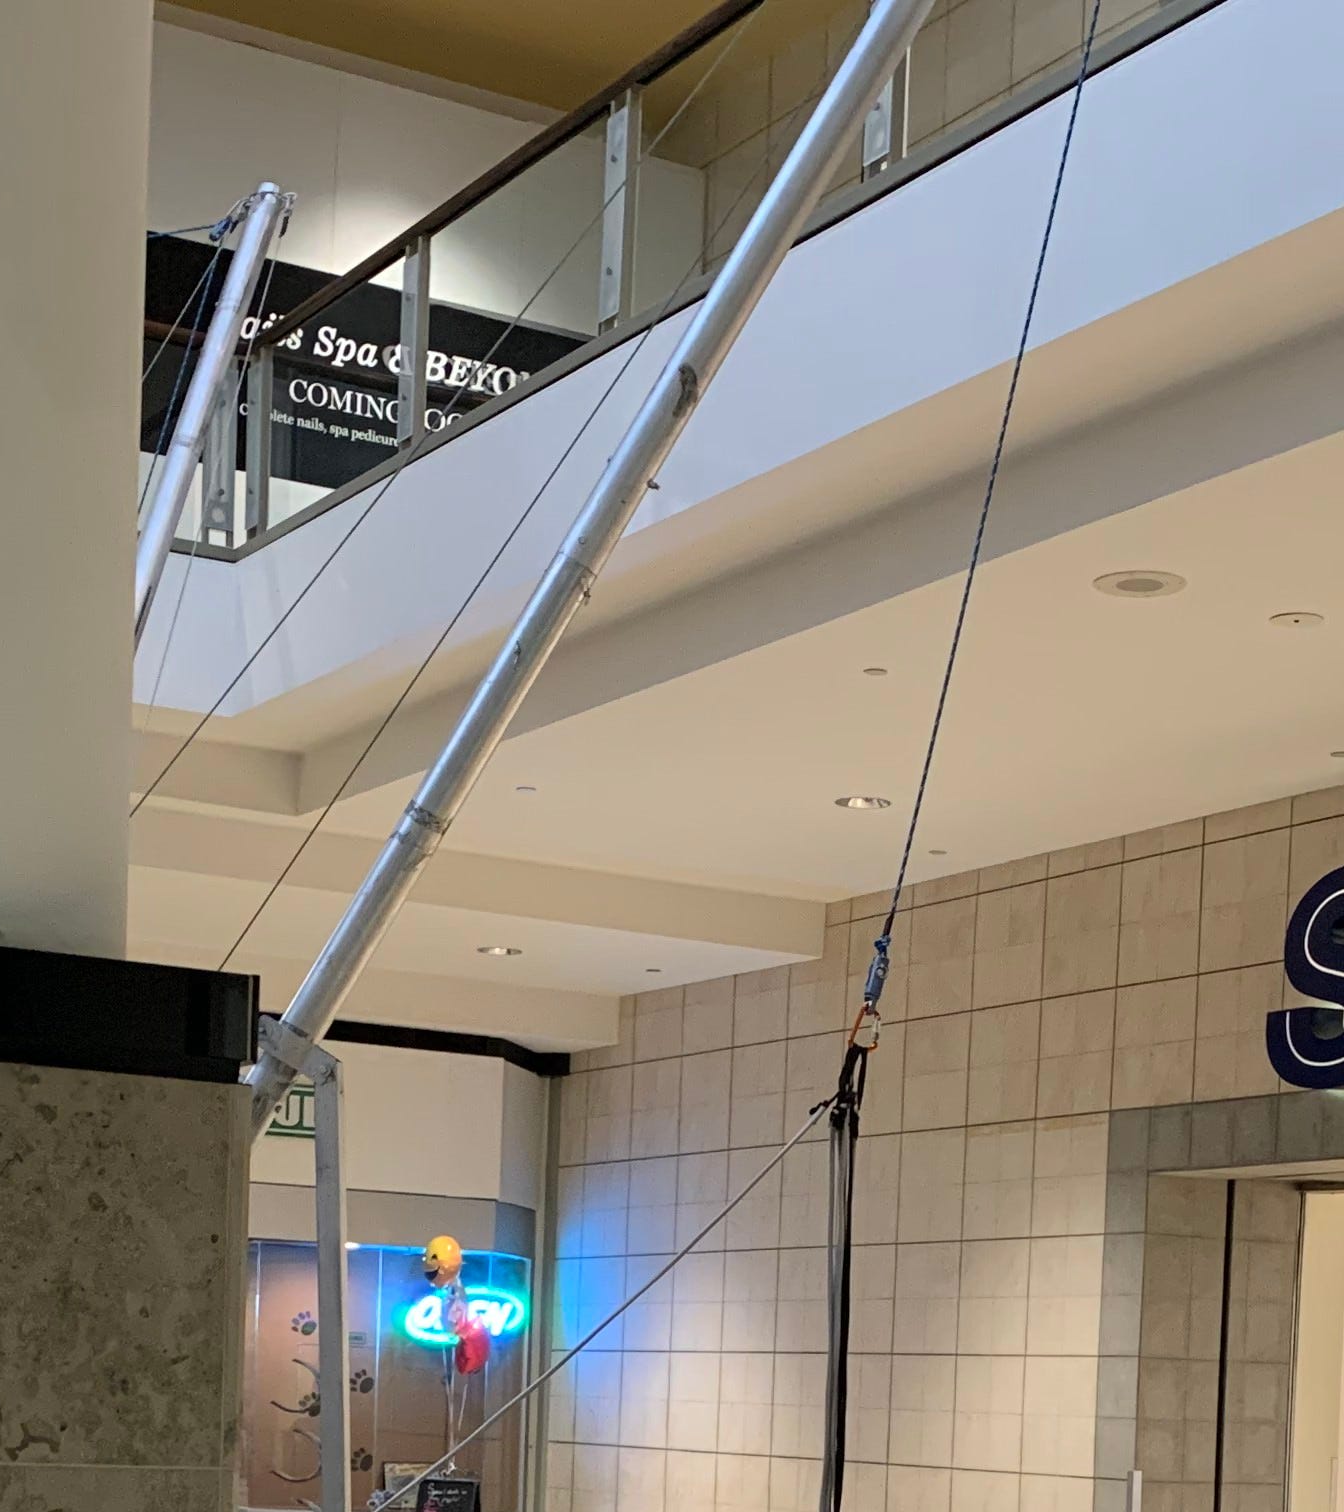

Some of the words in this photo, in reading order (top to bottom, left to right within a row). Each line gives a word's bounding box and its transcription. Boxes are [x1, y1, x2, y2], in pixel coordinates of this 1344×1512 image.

[313, 326, 378, 367] Spa
[425, 350, 531, 396] BEYO
[297, 417, 328, 434] nails,
[330, 425, 349, 438] spa
[412, 1294, 514, 1336] OEN
